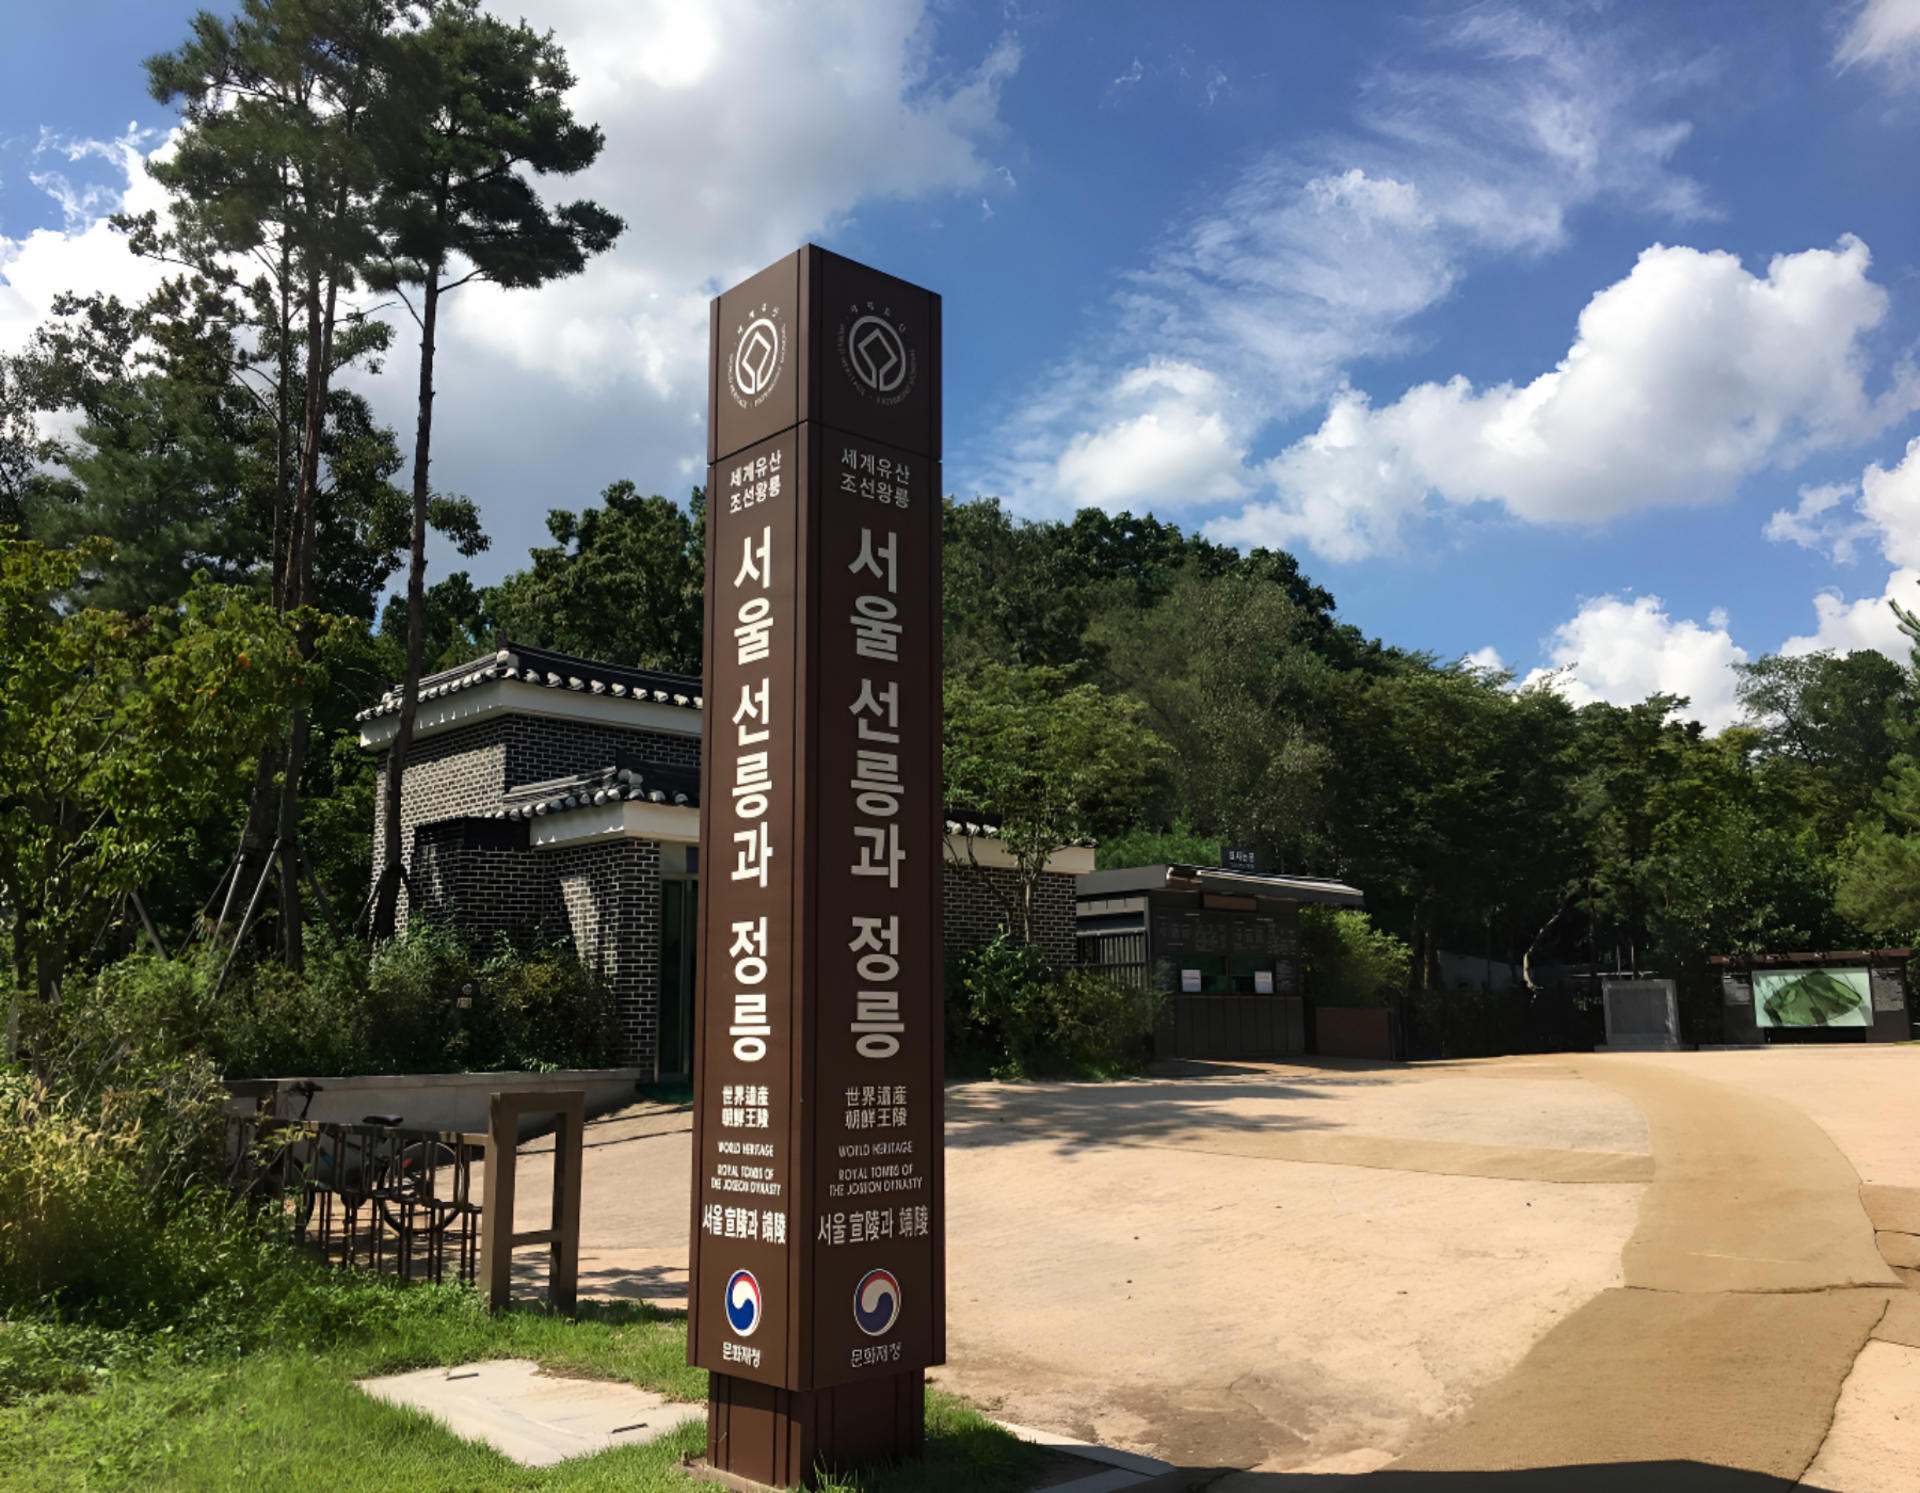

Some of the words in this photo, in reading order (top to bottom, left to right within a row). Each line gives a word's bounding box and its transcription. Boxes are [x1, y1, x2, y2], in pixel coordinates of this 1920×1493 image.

[730, 449, 782, 487] 세계유산
[841, 448, 910, 485] 세계유산
[729, 475, 782, 514] 조선왕릉
[840, 473, 910, 509] 조선왕릉
[733, 525, 774, 666] 서울
[848, 527, 903, 662] 서울
[731, 677, 774, 888] 선릉과
[848, 678, 906, 888] 선릉과
[729, 916, 771, 1062] 정릉
[848, 915, 905, 1059] 정릉
[845, 1085, 907, 1106] 世界遺産
[722, 1107, 769, 1128] 朝鮮王陵
[845, 1107, 907, 1130] 朝鮮王陵
[717, 1141, 741, 1155] WORLD
[742, 1143, 774, 1157] HERITAGE
[838, 1144, 871, 1158] WORLD
[872, 1140, 913, 1156] HERITAGE
[711, 1177, 722, 1190] THE
[723, 1178, 749, 1193] JOSEON
[750, 1181, 781, 1197] DYNASTY
[717, 1164, 739, 1178] ROYAL
[741, 1165, 763, 1180] TOMBS
[764, 1168, 774, 1180] OF
[829, 1183, 845, 1197] THE
[847, 1180, 882, 1196] JOSEON
[883, 1176, 923, 1192] DYNASTY
[838, 1167, 868, 1181] ROYAL
[871, 1164, 900, 1179] TOMBS
[901, 1163, 913, 1176] OF
[702, 1204, 723, 1236] 서울
[724, 1207, 759, 1241] 宣陵과
[817, 1212, 847, 1246] 서울
[849, 1208, 893, 1245] 宣陵과
[722, 1341, 761, 1368] 문화재청
[850, 1341, 903, 1368] 문화재청
